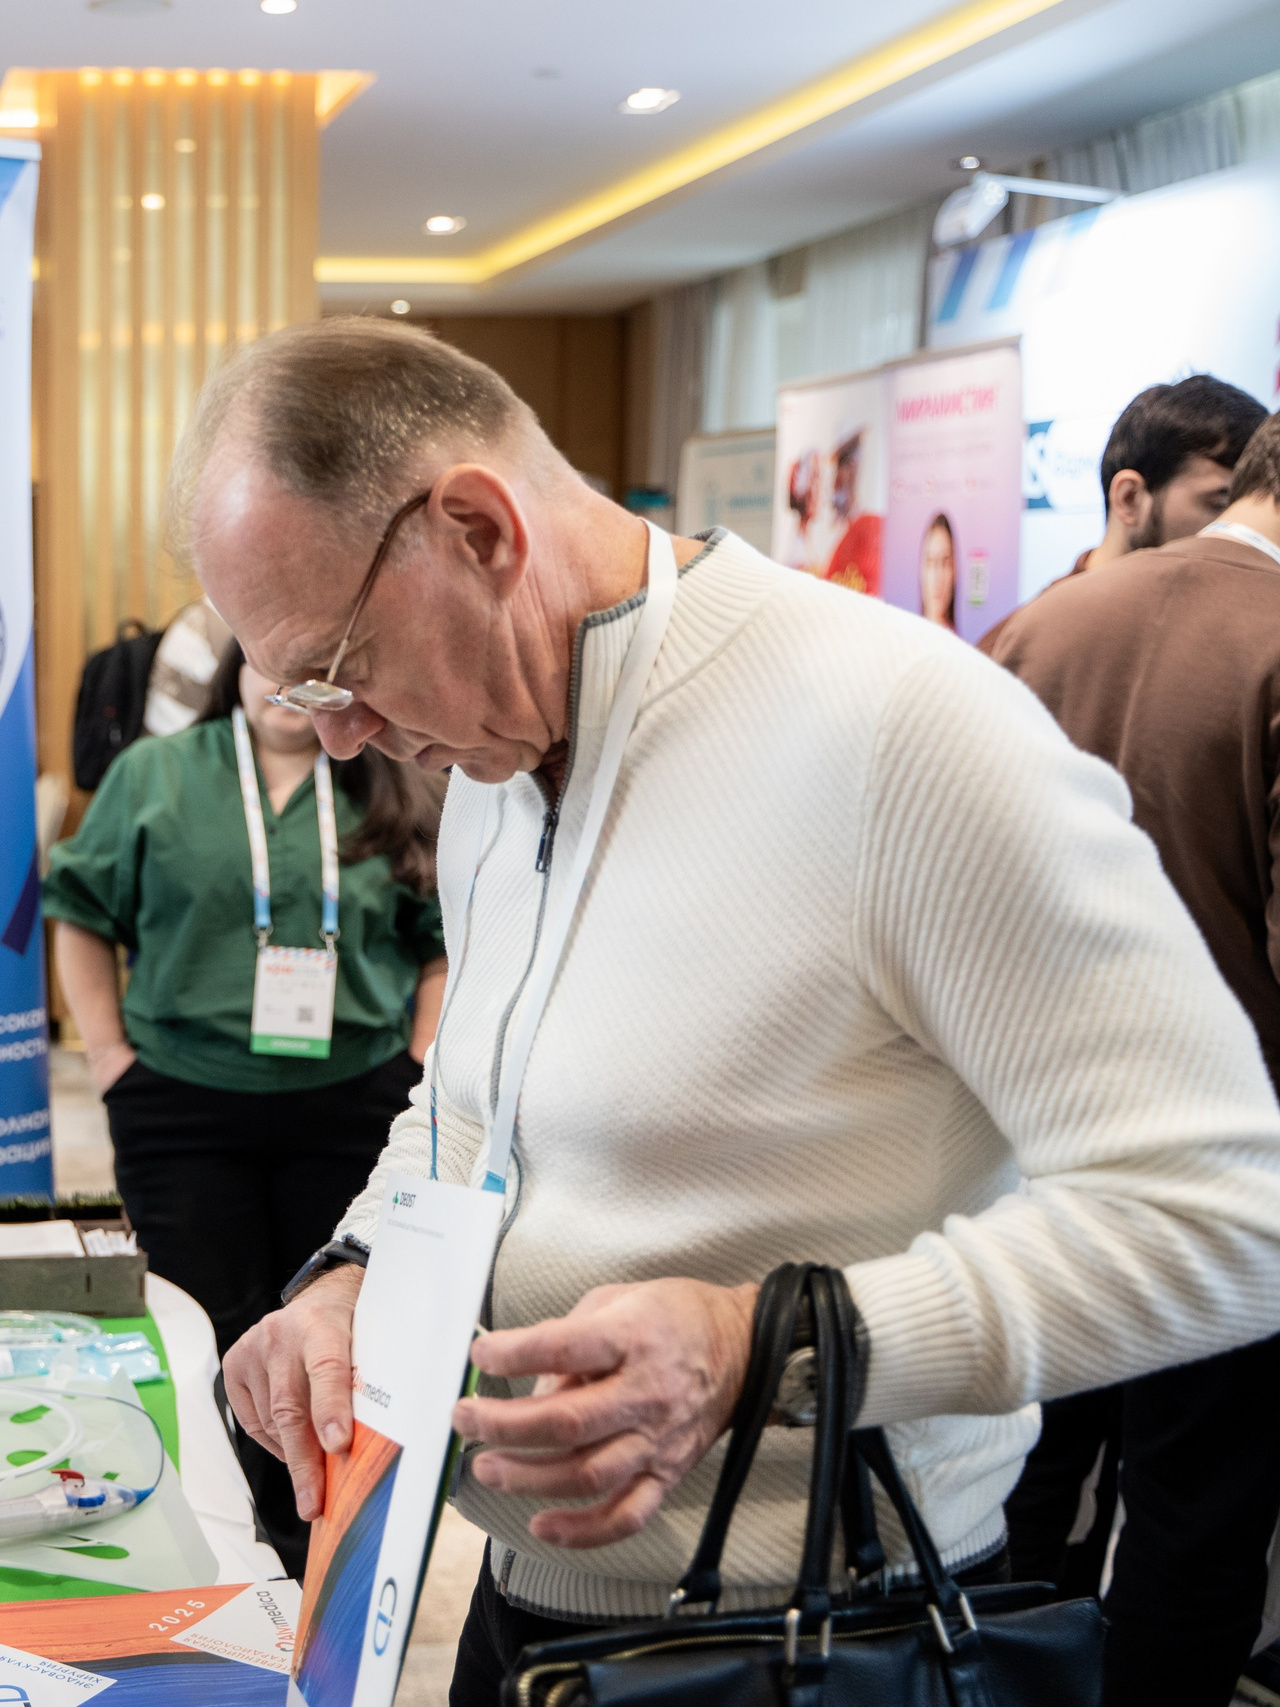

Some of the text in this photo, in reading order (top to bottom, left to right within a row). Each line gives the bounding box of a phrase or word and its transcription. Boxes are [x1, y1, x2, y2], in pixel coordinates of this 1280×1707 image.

[399, 1191, 417, 1208] DEOST
[148, 1599, 206, 1632] 2025
[183, 1636, 293, 1672] ТЕРВЕНЦИОННАЯ
[190, 1632, 288, 1663] КАРДИОЛОГИЯ
[38, 1660, 104, 1684] ХИРУРГИЯ
